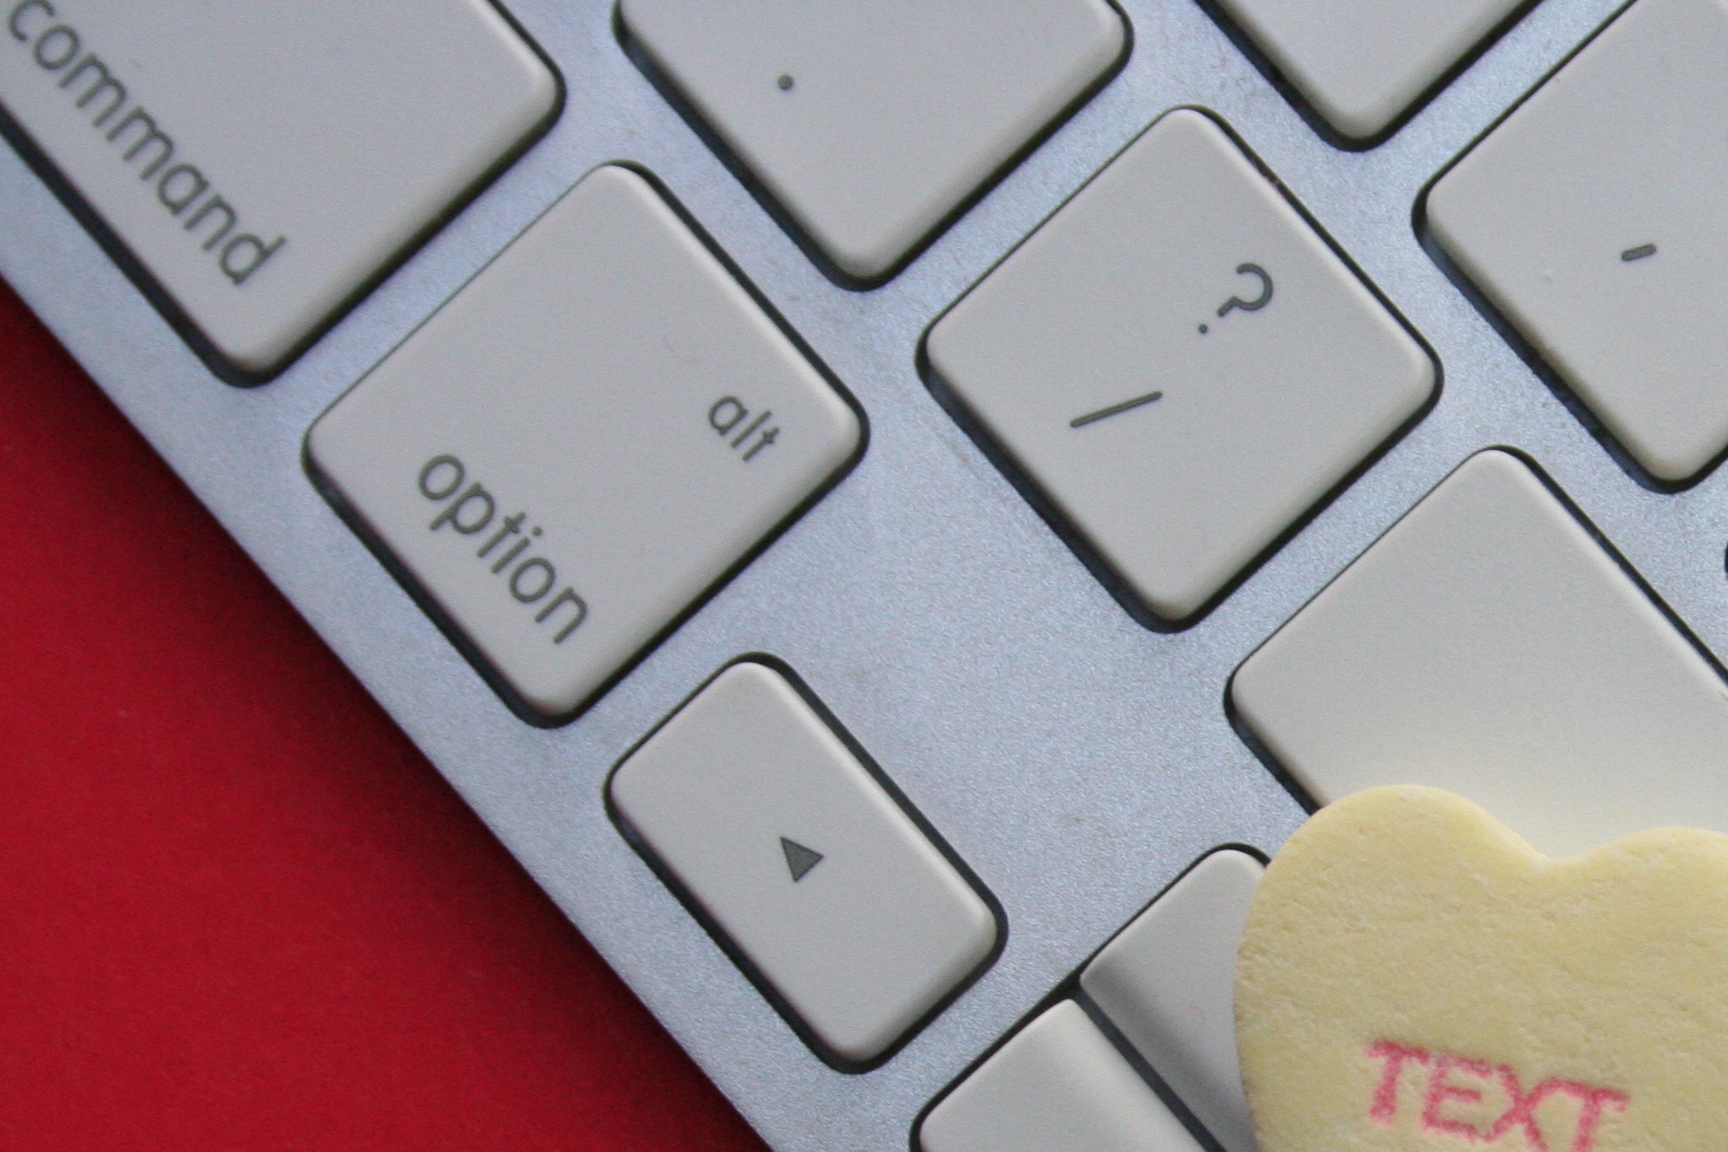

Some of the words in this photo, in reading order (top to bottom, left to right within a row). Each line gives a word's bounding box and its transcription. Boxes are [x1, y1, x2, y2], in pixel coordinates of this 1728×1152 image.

[8, 0, 287, 286] command
[1197, 261, 1274, 335] ?
[706, 394, 780, 463] alt
[416, 452, 588, 645] option
